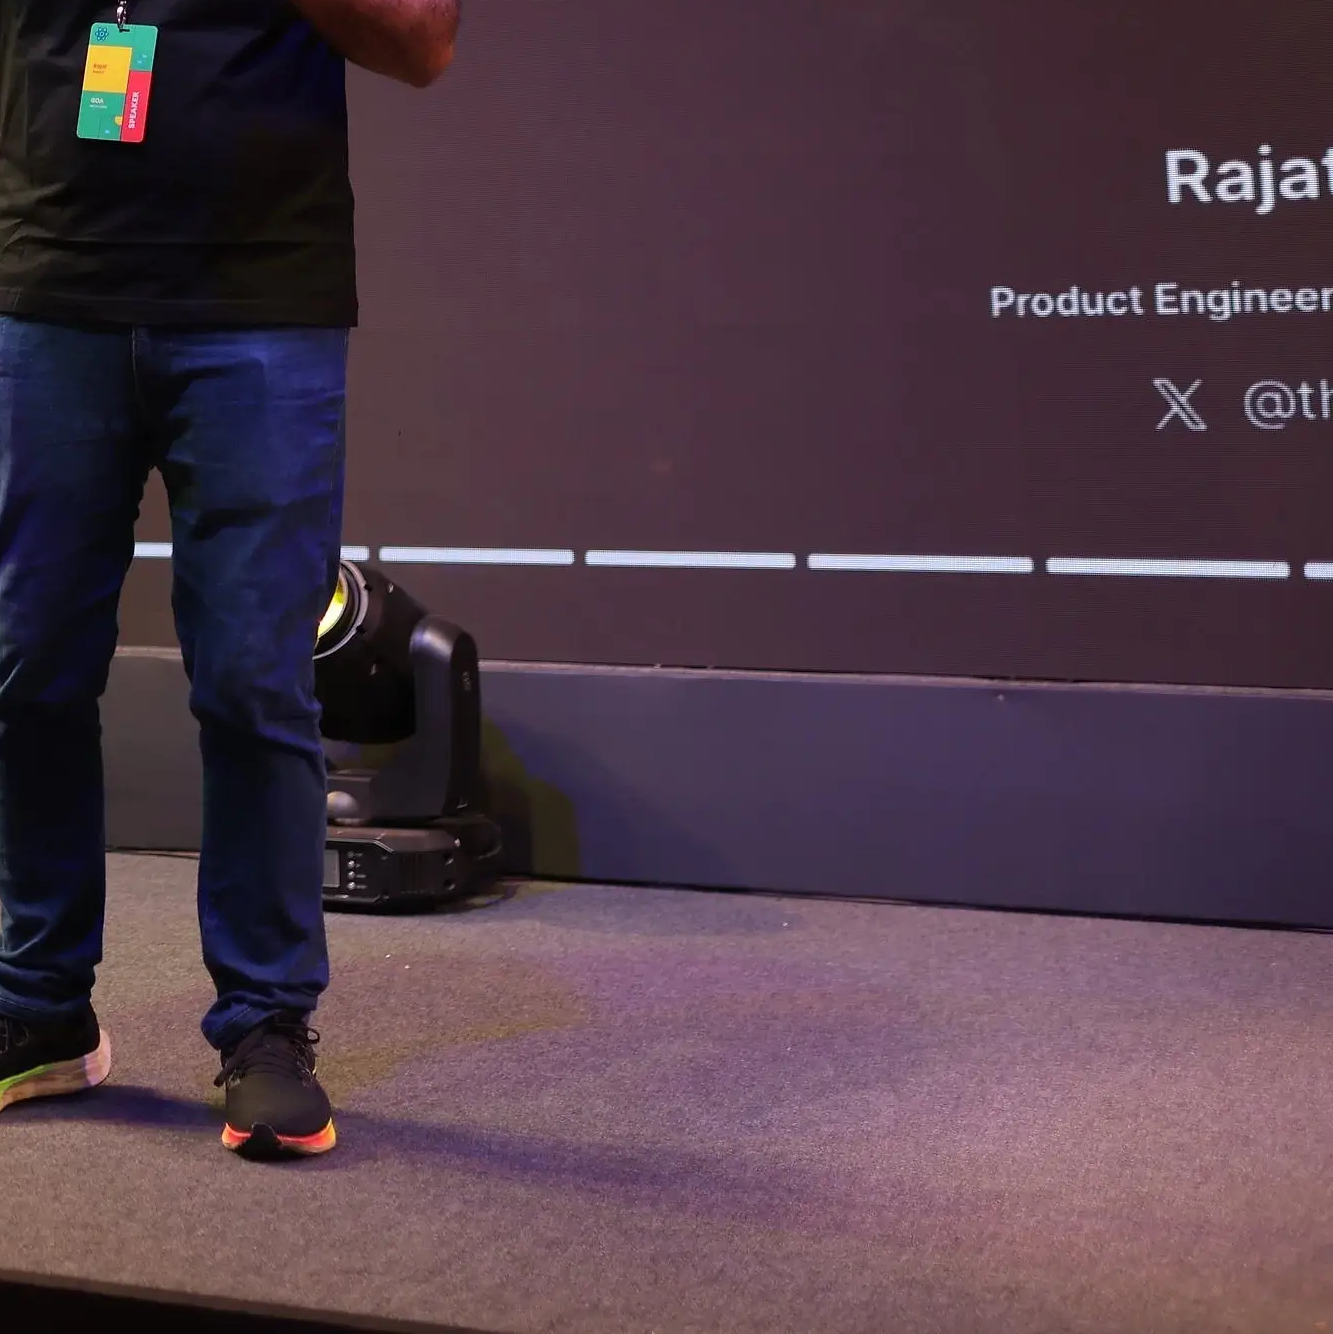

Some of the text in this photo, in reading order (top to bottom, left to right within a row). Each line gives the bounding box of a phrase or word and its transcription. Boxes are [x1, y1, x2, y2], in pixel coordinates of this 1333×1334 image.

[128, 91, 139, 129] SPEAKER
[990, 280, 1333, 322] Product Engineer
